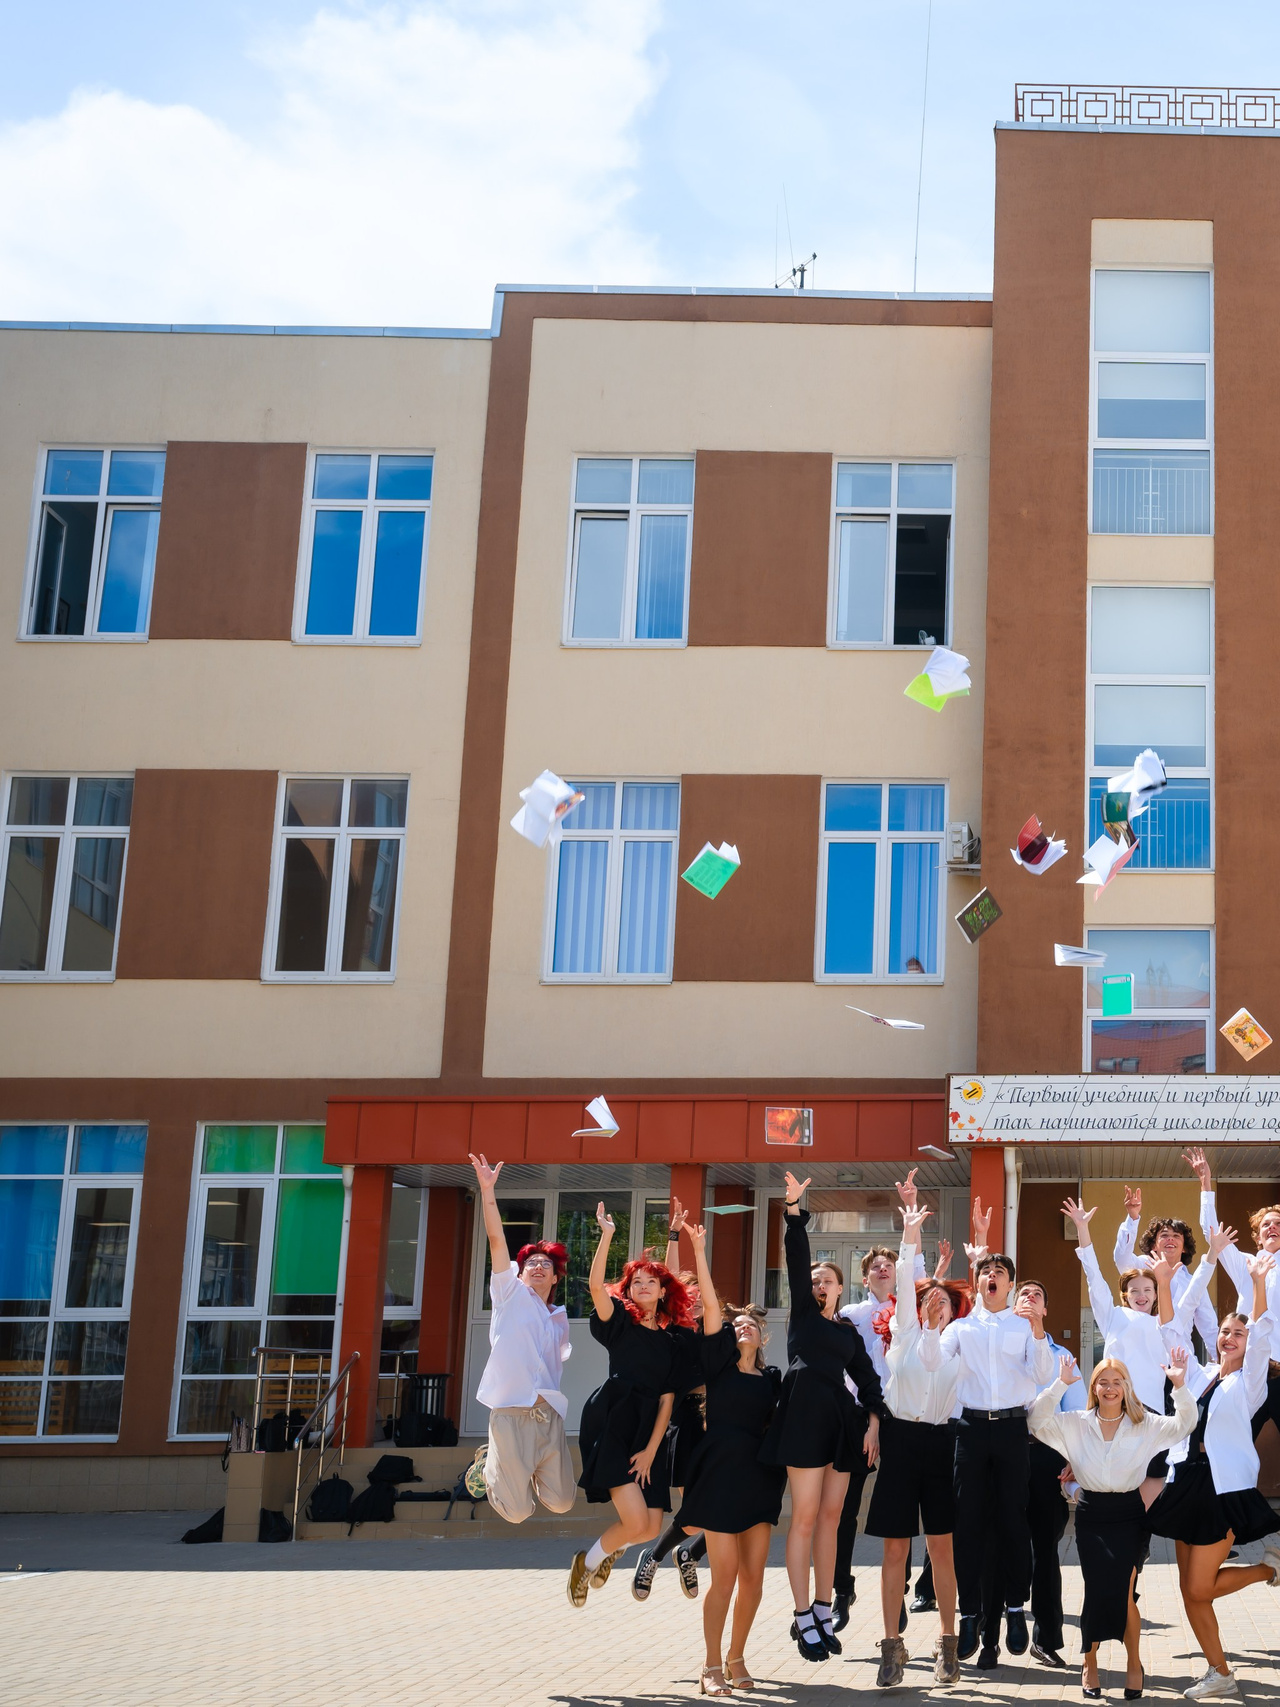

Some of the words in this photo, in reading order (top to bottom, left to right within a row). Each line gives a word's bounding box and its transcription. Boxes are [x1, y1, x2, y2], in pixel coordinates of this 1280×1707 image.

[1082, 1085, 1159, 1107] учебник
[1166, 1090, 1180, 1102] и
[1183, 1085, 1253, 1107] первый
[993, 1113, 1036, 1129] так
[1040, 1113, 1159, 1130] начинаются
[1163, 1117, 1256, 1131] школьные
